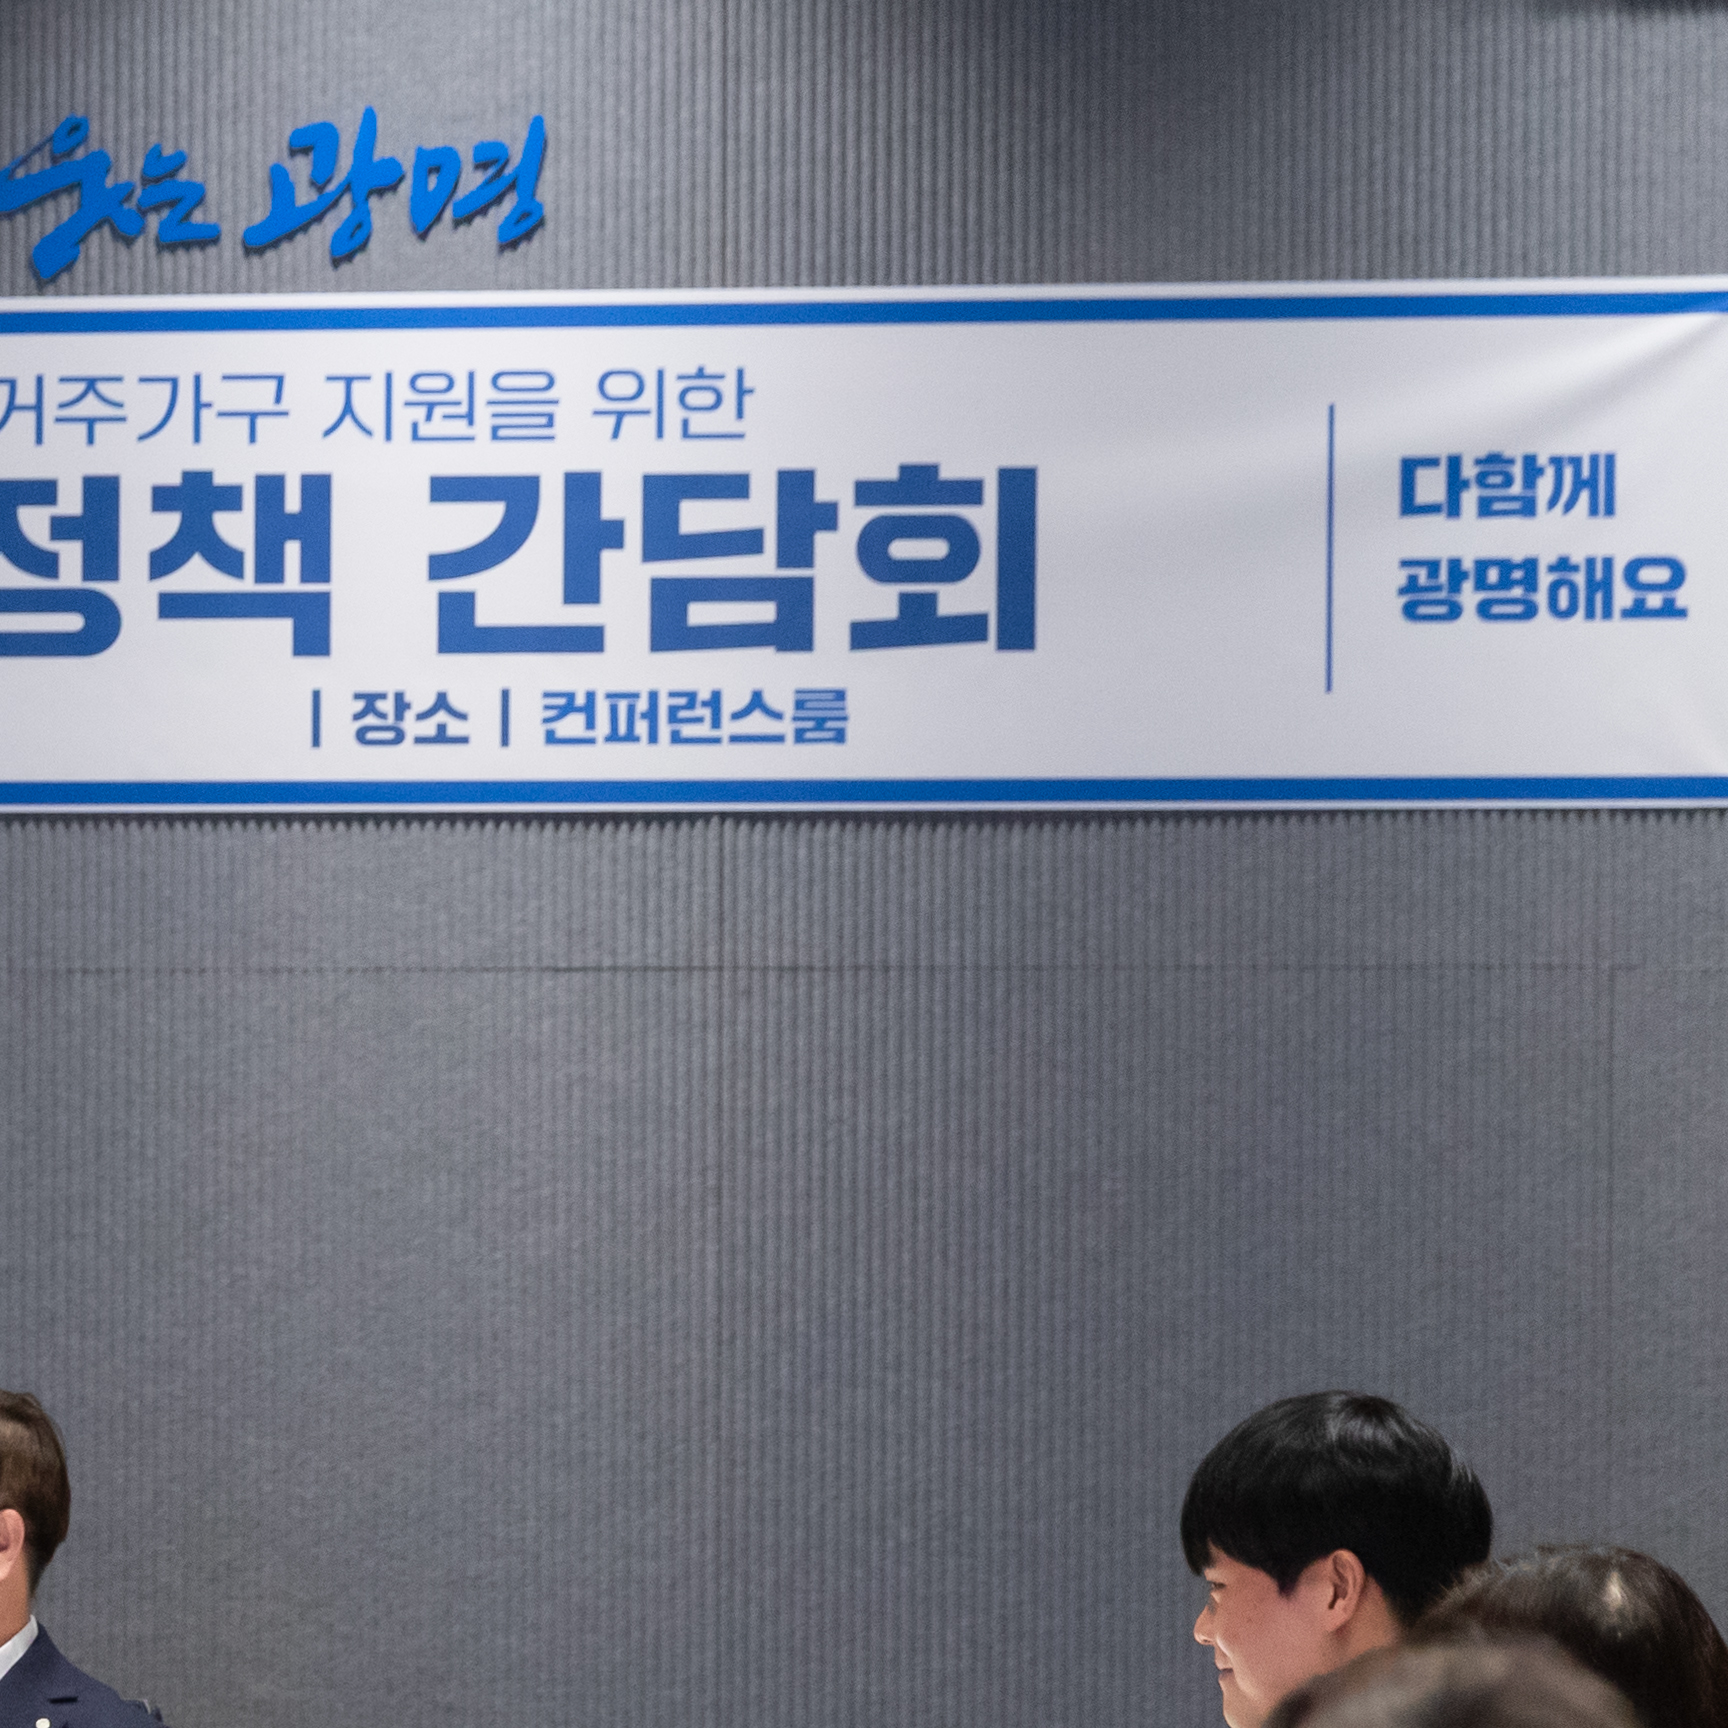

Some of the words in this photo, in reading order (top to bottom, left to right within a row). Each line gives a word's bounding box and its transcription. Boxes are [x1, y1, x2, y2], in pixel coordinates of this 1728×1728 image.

[243, 105, 546, 258] 광명
[322, 369, 561, 443] 지원을
[592, 365, 756, 441] 위한
[1399, 451, 1617, 520] 다함께
[427, 463, 1037, 655] 간담회
[1396, 555, 1689, 624] 광명해요
[352, 691, 470, 747] 장소
[541, 687, 850, 746] 컨퍼런스룸
